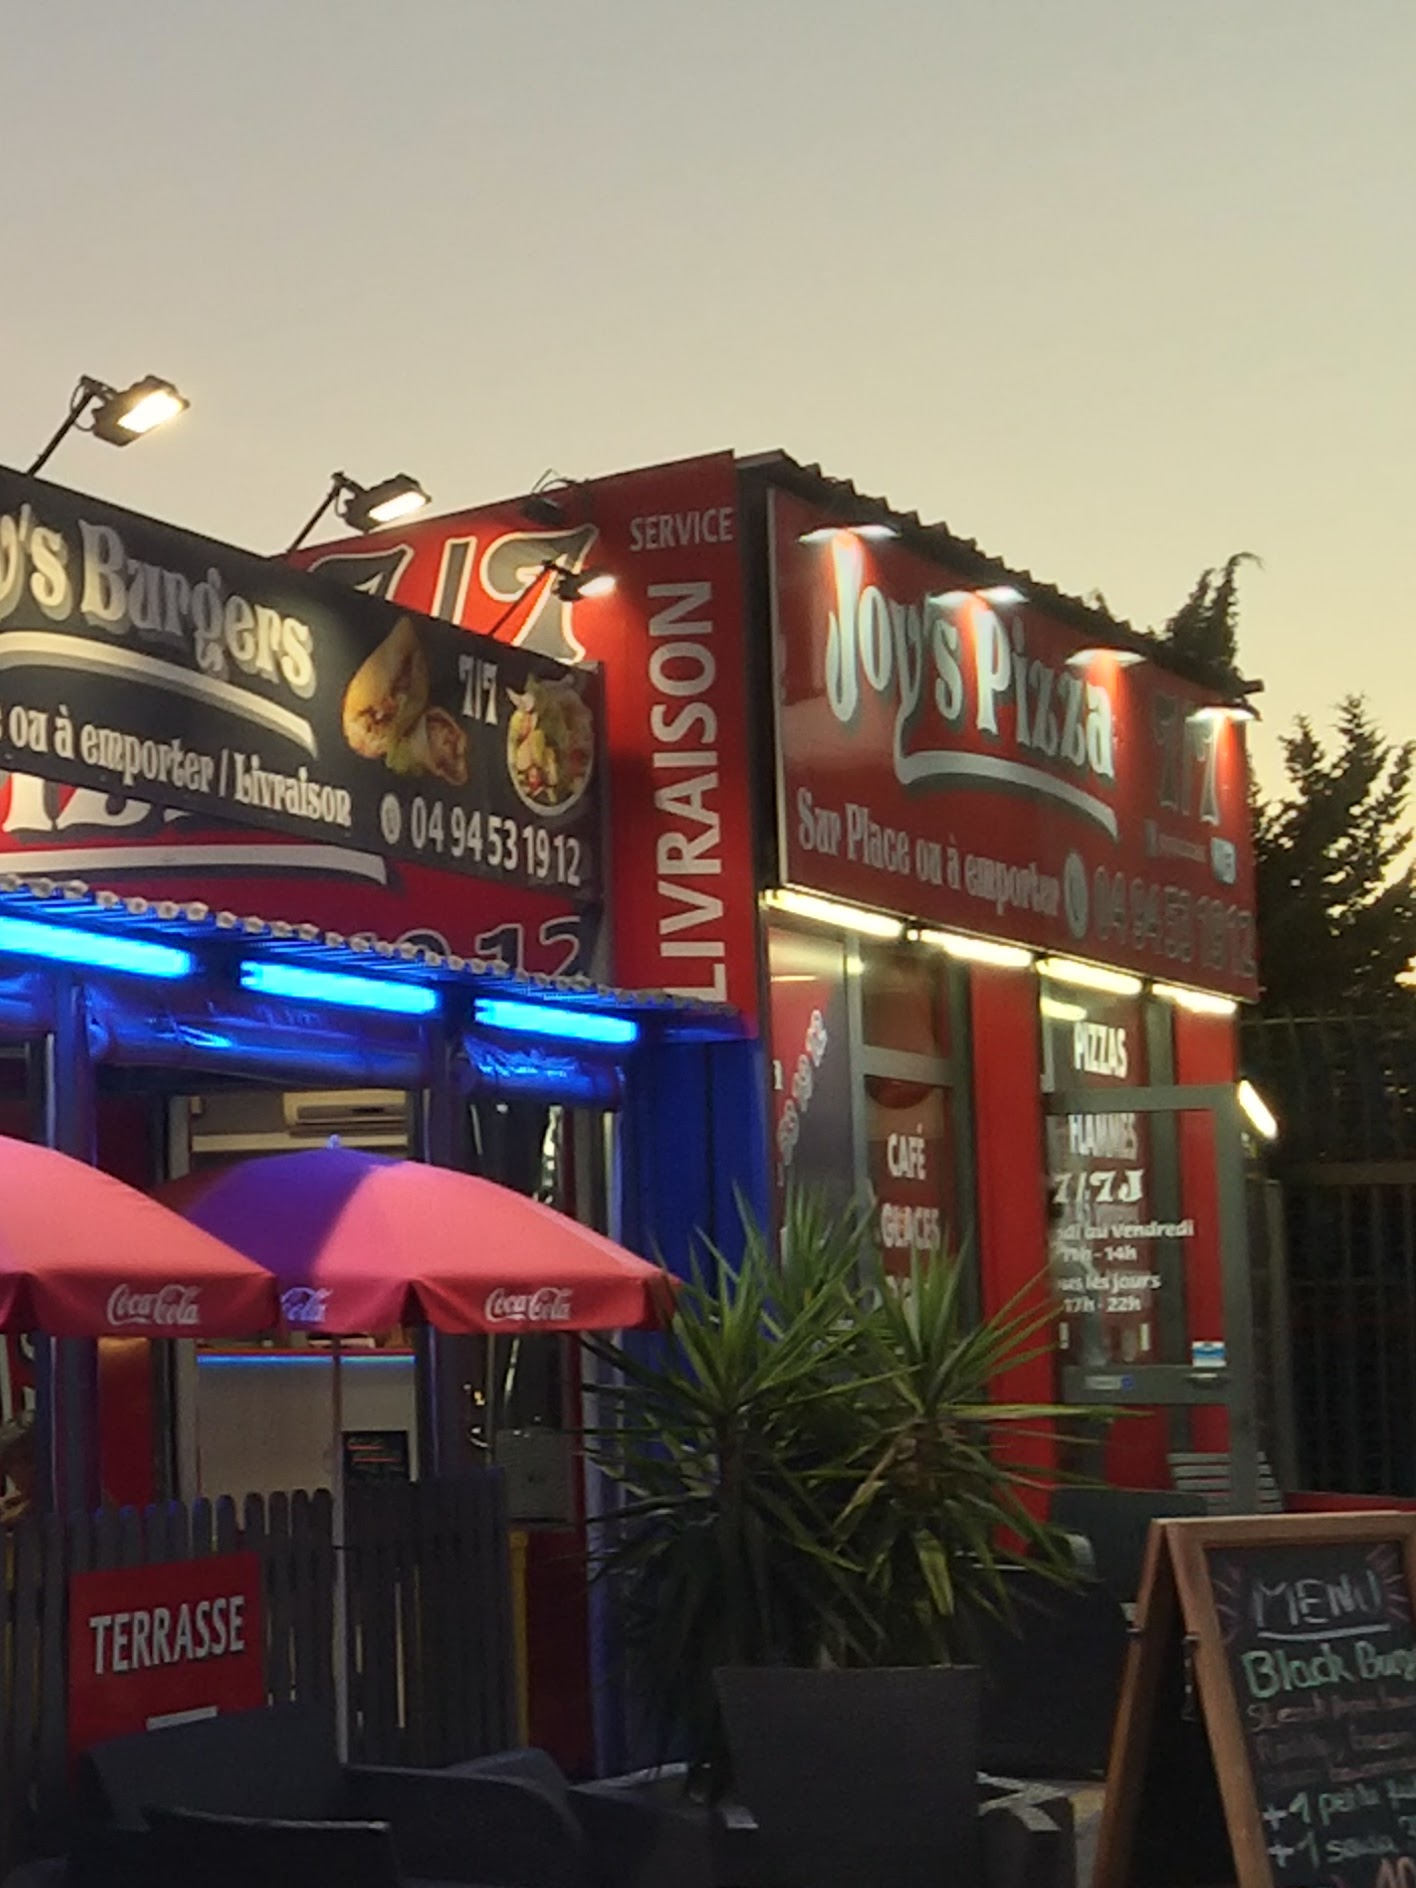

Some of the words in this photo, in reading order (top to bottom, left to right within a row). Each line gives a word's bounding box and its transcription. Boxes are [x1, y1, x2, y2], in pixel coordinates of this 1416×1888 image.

[629, 508, 734, 552] SERVICE
[79, 520, 316, 697] Burgers
[458, 654, 499, 725] 7/7
[825, 531, 965, 762] Joy's
[973, 596, 1117, 783] Pizza
[9, 707, 48, 753] ou
[53, 704, 75, 759] à
[80, 723, 214, 793] emporter
[234, 757, 353, 828] Livraison
[647, 581, 728, 1003] LIVRAISON
[411, 796, 445, 853] 04
[451, 806, 483, 862] 94
[488, 814, 518, 870] 53
[523, 825, 550, 878] 19
[554, 834, 581, 887] 12
[796, 786, 841, 857] Sur
[845, 802, 911, 875] Place
[916, 837, 943, 886] ou
[947, 832, 961, 890] à
[964, 852, 1060, 916] emporter
[1074, 1021, 1128, 1080] PIZZAS
[886, 1124, 926, 1180] CAFÉ
[1107, 1296, 1142, 1312] 22h
[1111, 1273, 1162, 1294] jours
[89, 1594, 246, 1675] TERRASSE
[1251, 1569, 1383, 1629] MENU
[1241, 1642, 1355, 1700] Black
